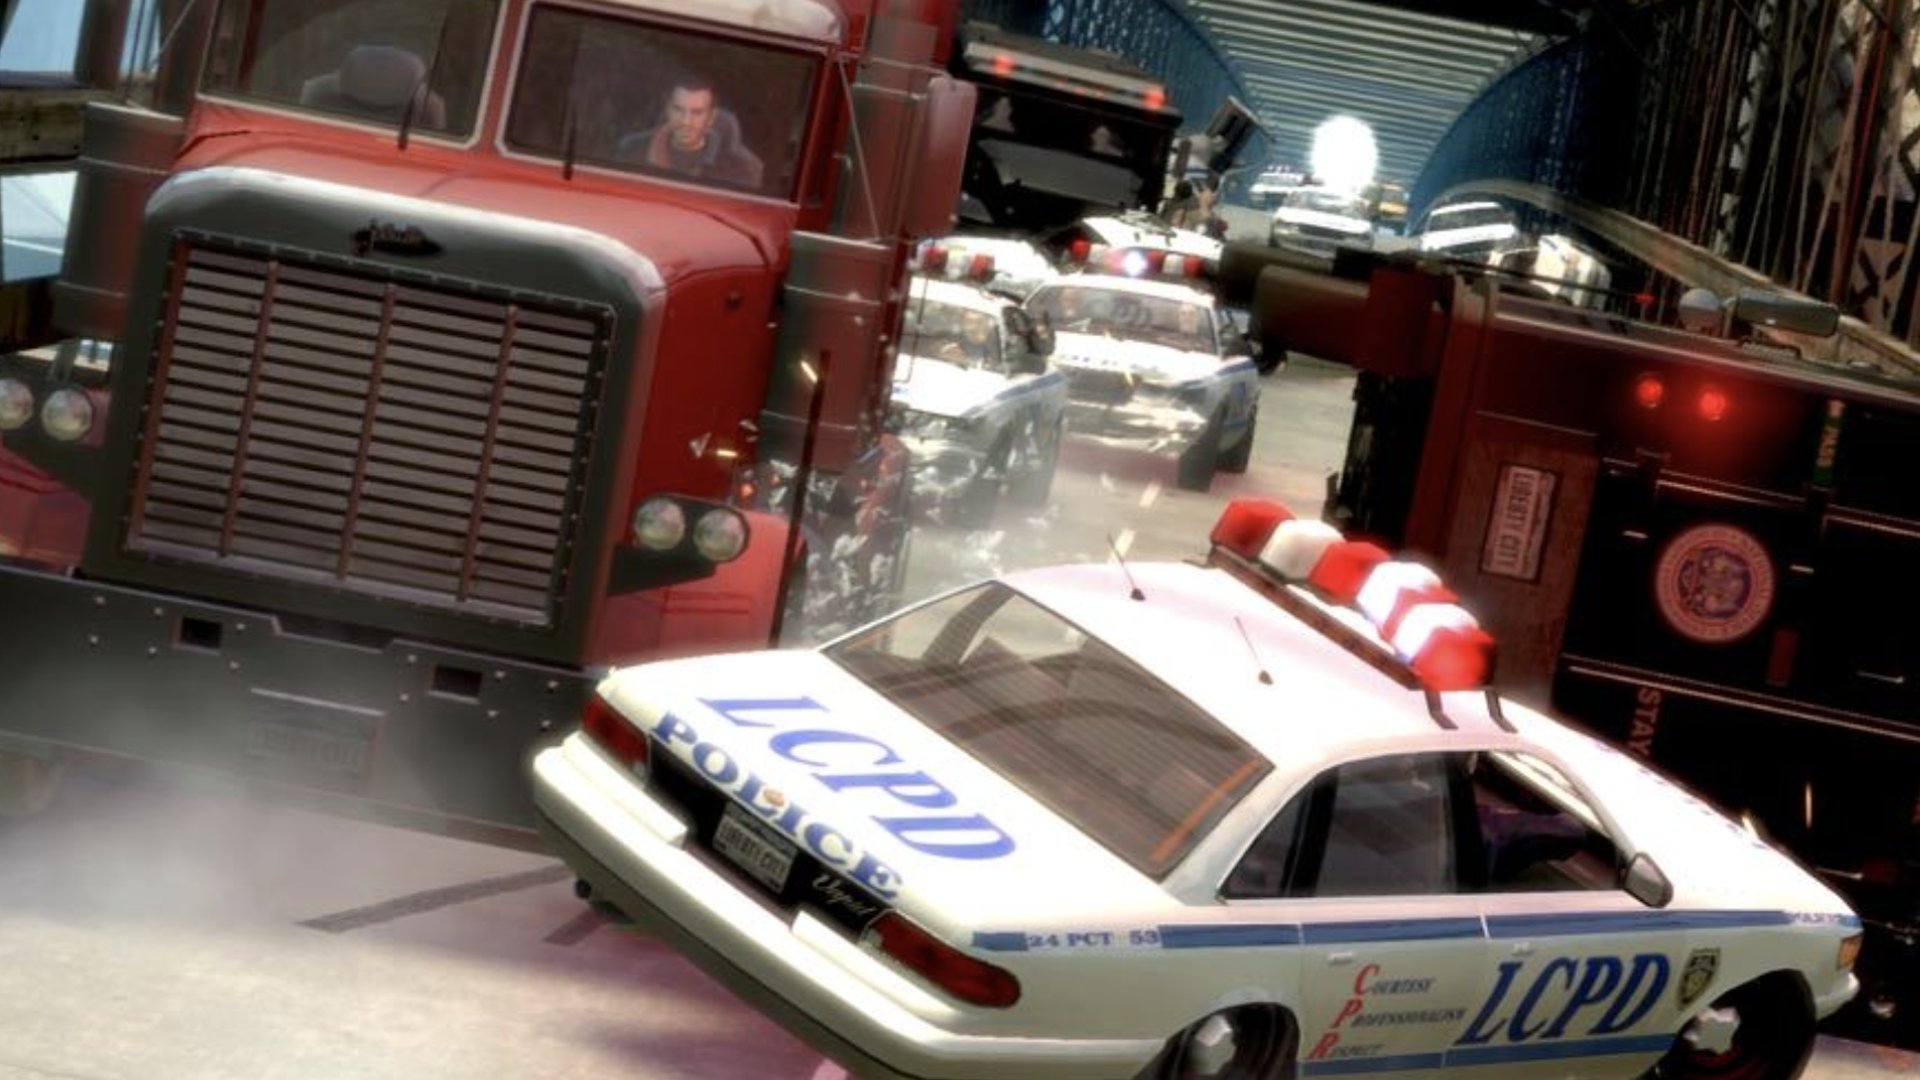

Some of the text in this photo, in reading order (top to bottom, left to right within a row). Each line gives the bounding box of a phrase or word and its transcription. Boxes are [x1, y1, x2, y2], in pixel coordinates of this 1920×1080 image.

[1497, 534, 1520, 567] CITY
[1629, 686, 1662, 755] STAY
[651, 711, 905, 898] POLICE
[696, 696, 1017, 861] LCPD
[1028, 929, 1160, 948] 24 PCT 53
[1454, 952, 1670, 1045] LCPD
